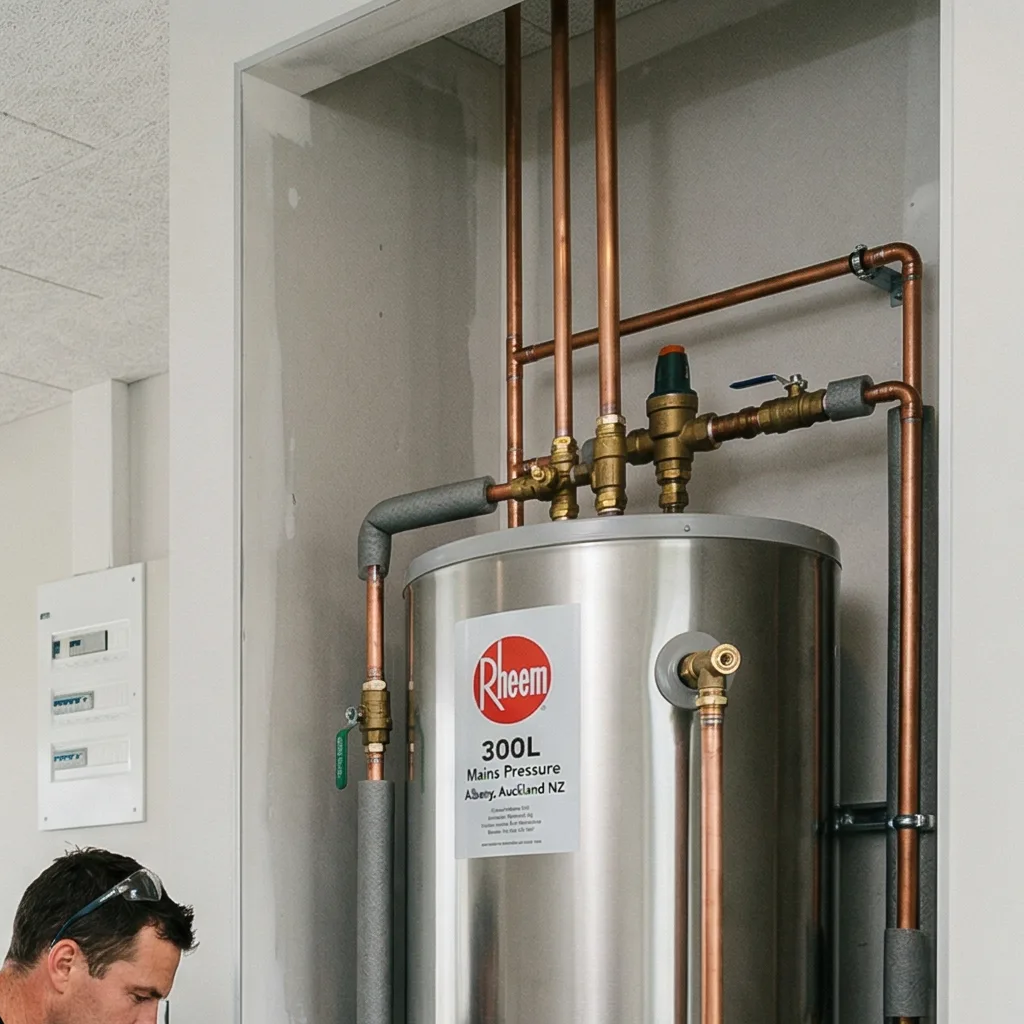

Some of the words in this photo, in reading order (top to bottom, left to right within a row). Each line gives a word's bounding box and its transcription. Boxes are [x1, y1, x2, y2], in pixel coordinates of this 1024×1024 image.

[480, 640, 547, 711] Rheem
[482, 736, 541, 762] 300L
[467, 767, 500, 782] Mains
[504, 764, 561, 779] Pressure
[548, 781, 565, 794] NZ
